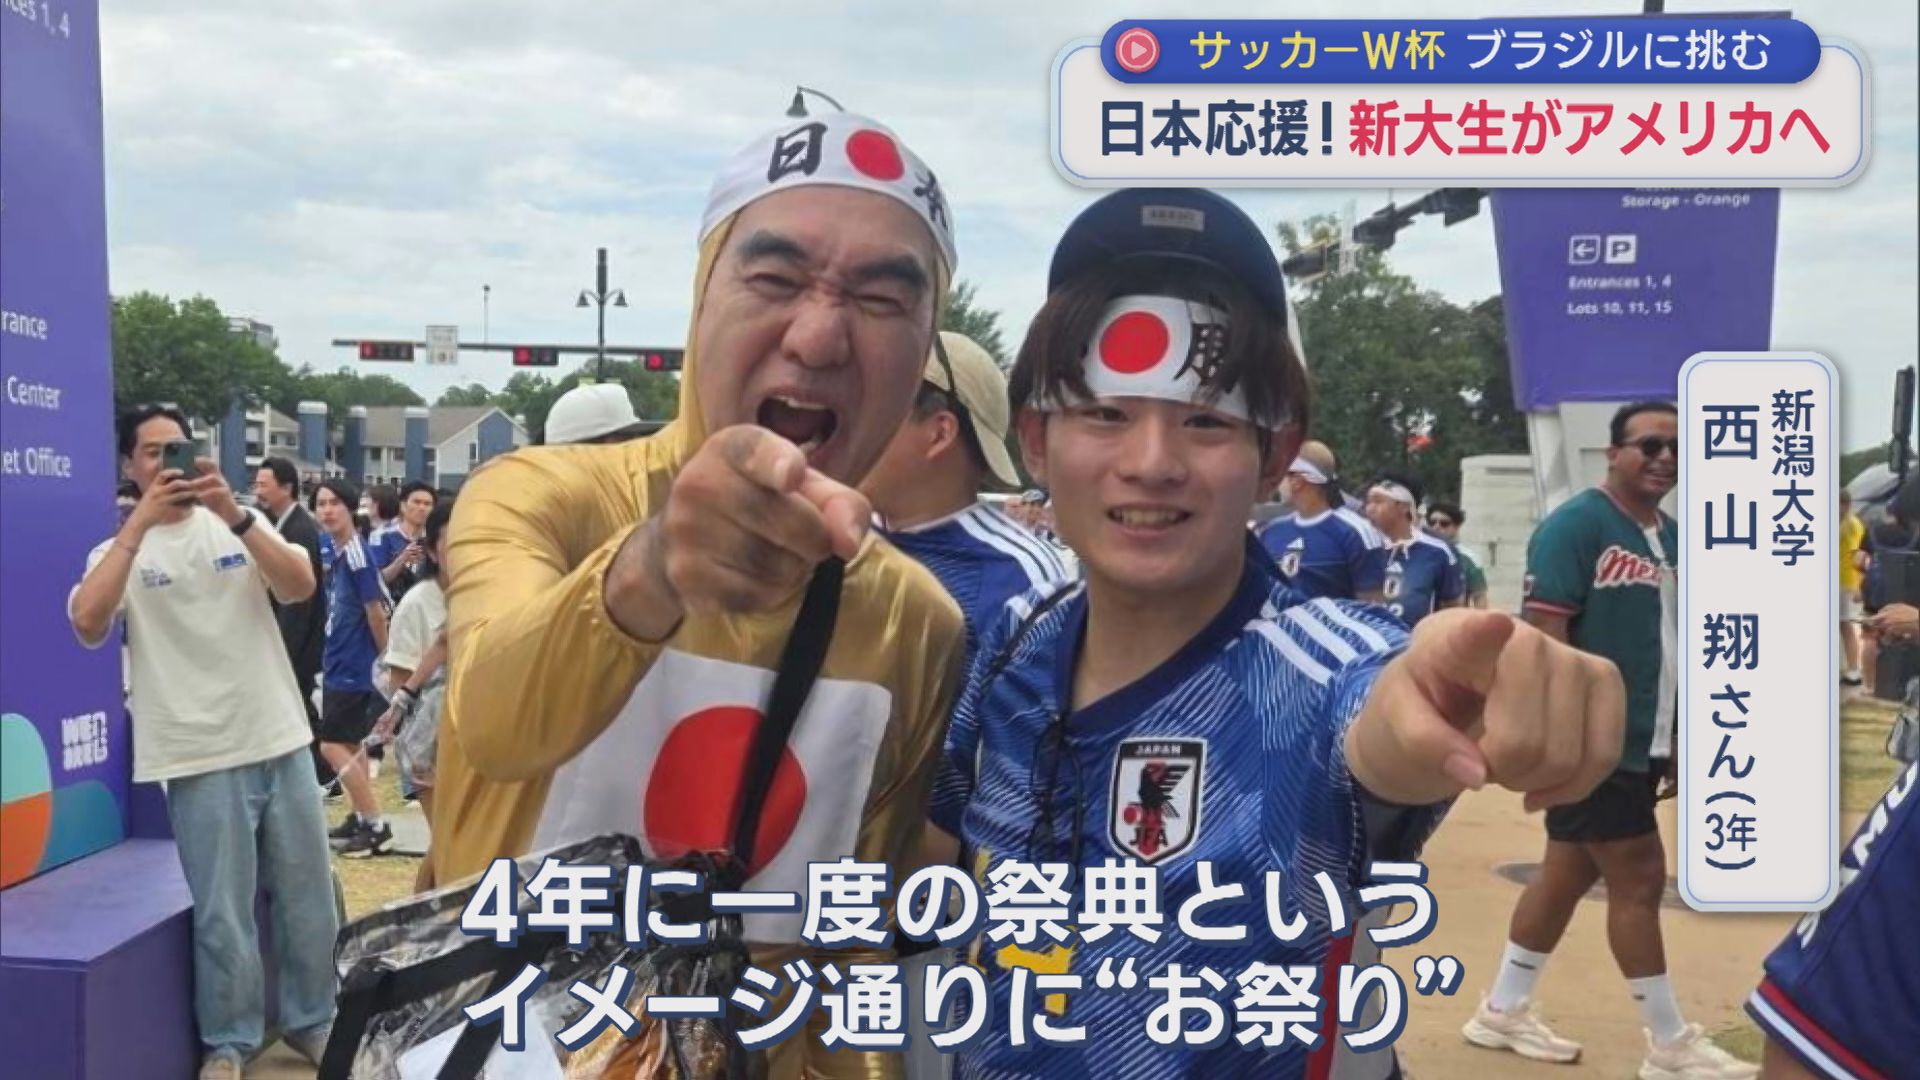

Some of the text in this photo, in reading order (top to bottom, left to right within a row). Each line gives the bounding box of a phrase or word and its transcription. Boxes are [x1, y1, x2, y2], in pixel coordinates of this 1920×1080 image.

[58, 11, 70, 40] 4
[1621, 194, 1680, 210] Storage
[1694, 193, 1750, 208] Orange
[1568, 275, 1641, 290] Entrances
[1662, 274, 1672, 288] 4
[1567, 301, 1599, 316] Lots
[1603, 301, 1624, 317] 10,
[1655, 301, 1673, 315] 15
[8, 375, 61, 411] Center
[25, 447, 72, 479] Office
[1136, 744, 1182, 755] JAPAN
